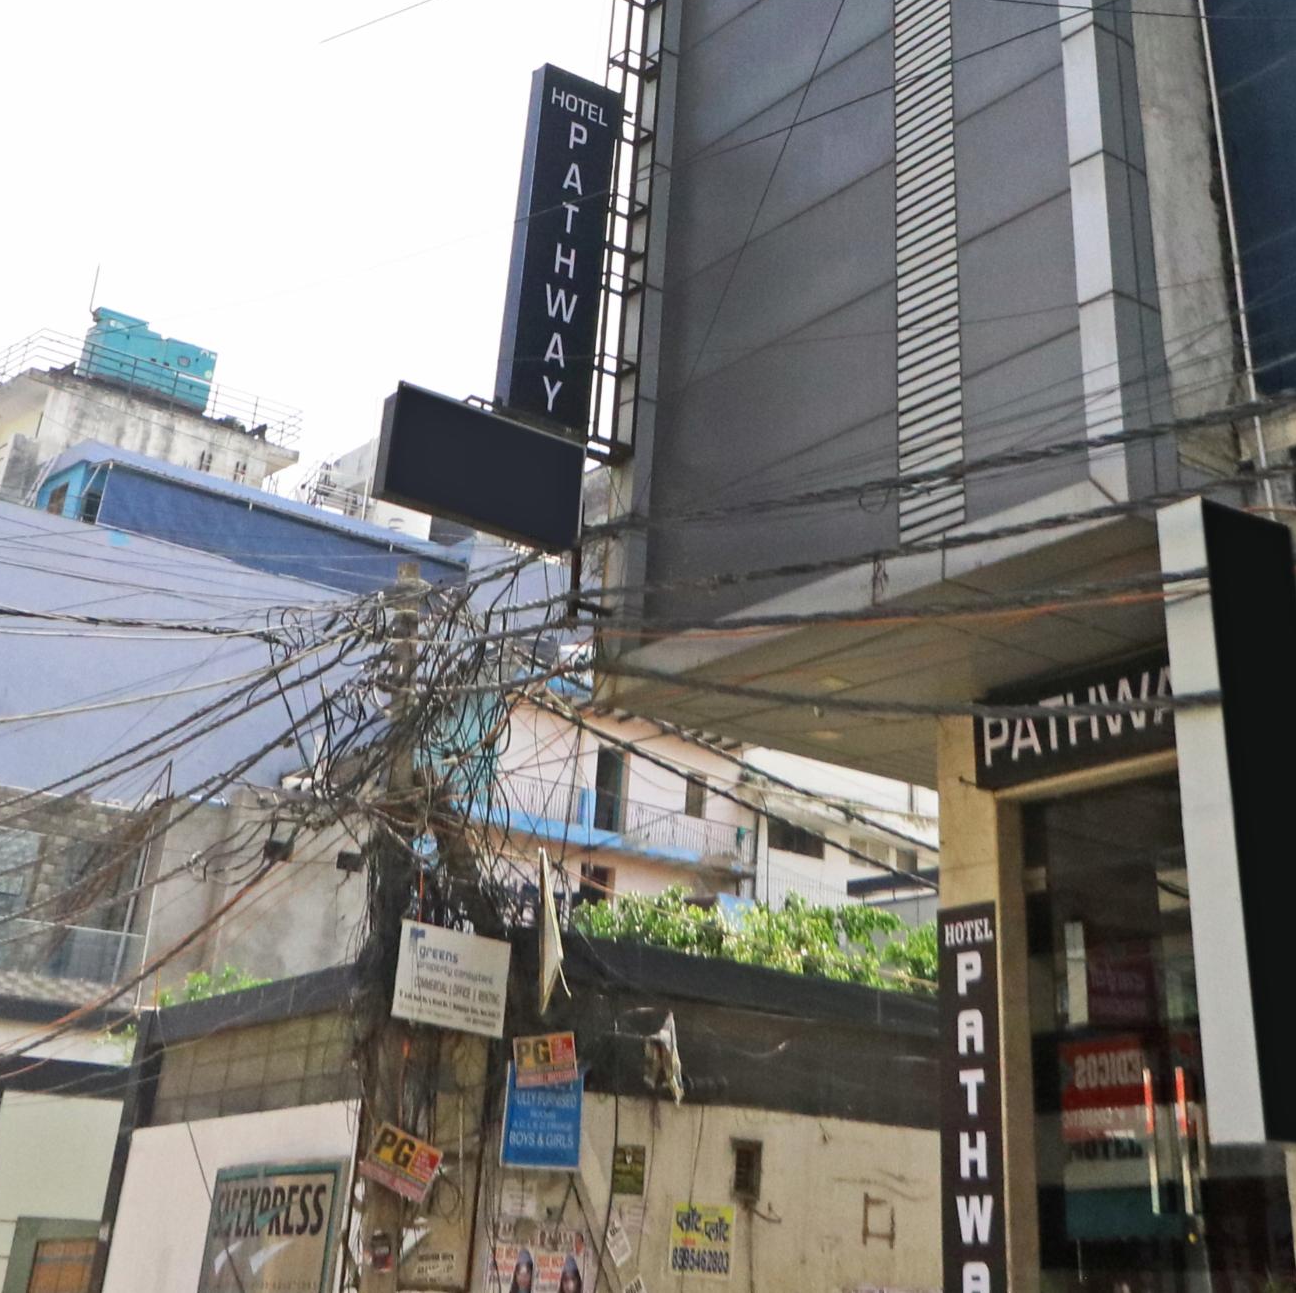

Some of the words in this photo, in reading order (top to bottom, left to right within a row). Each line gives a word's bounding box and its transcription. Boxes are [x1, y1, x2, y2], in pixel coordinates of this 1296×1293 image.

[551, 86, 608, 127] HOTEL
[543, 121, 588, 412] PATHWAY
[983, 665, 1173, 768] PATHWA
[944, 917, 994, 947] HOTEL
[516, 1038, 552, 1066] PG
[509, 1130, 536, 1147] BOYS
[545, 1133, 574, 1149] GIRLS
[955, 950, 994, 1293] PATHWA
[374, 1127, 417, 1169] PG
